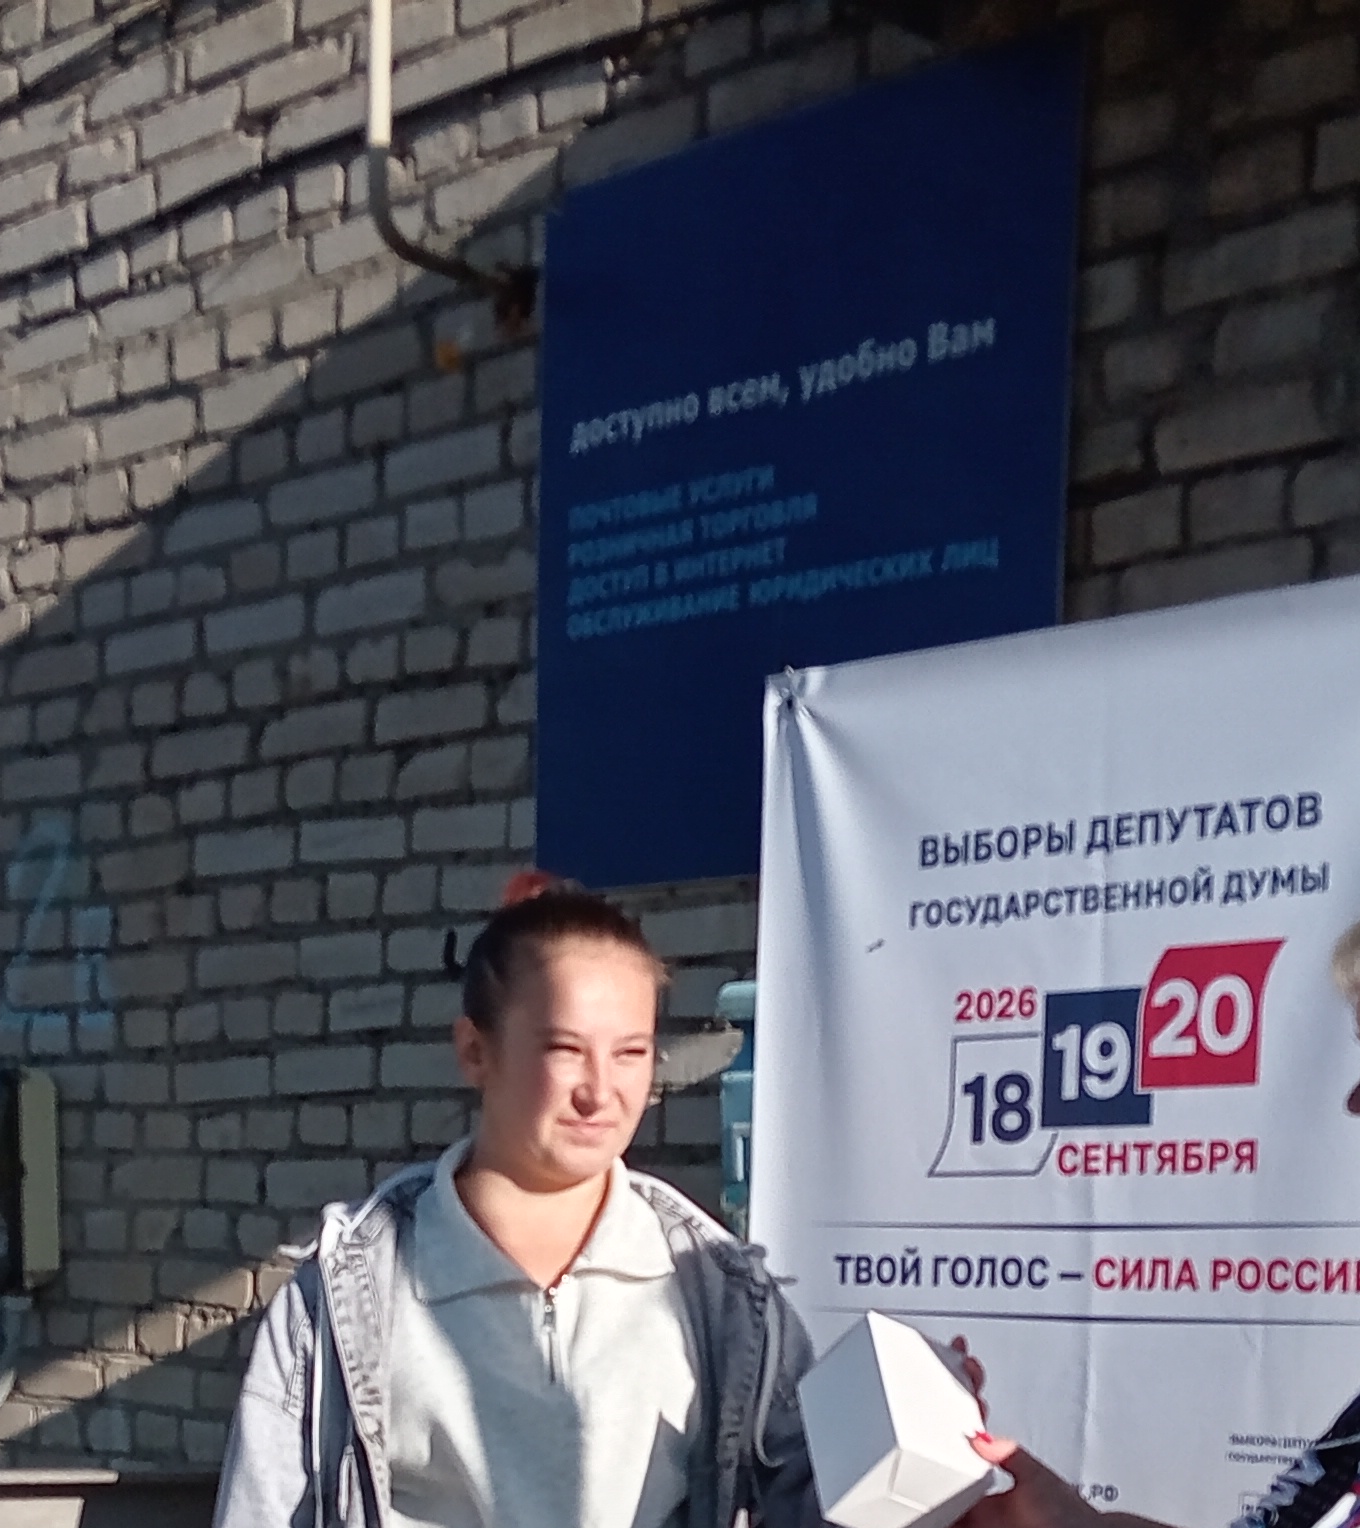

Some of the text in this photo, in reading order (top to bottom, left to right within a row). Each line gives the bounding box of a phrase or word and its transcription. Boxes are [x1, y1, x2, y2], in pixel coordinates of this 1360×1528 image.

[707, 371, 789, 416] всем,
[798, 337, 918, 403] удобно
[926, 317, 996, 365] Вам
[919, 792, 1323, 870] ВЫБОРЫ ДЕПУТАТОВ
[909, 863, 1330, 929] ГОСУДАРСТВЕННОЙ ДУМЫ
[955, 987, 1036, 1023] 2026
[962, 975, 1254, 1145] 18 19 20
[1057, 1139, 1258, 1177] СЕНТЯБРЯ
[835, 1247, 921, 1288] ТВОЙ
[931, 1255, 1050, 1290] ГОЛОС
[1094, 1258, 1200, 1293] СИЛА
